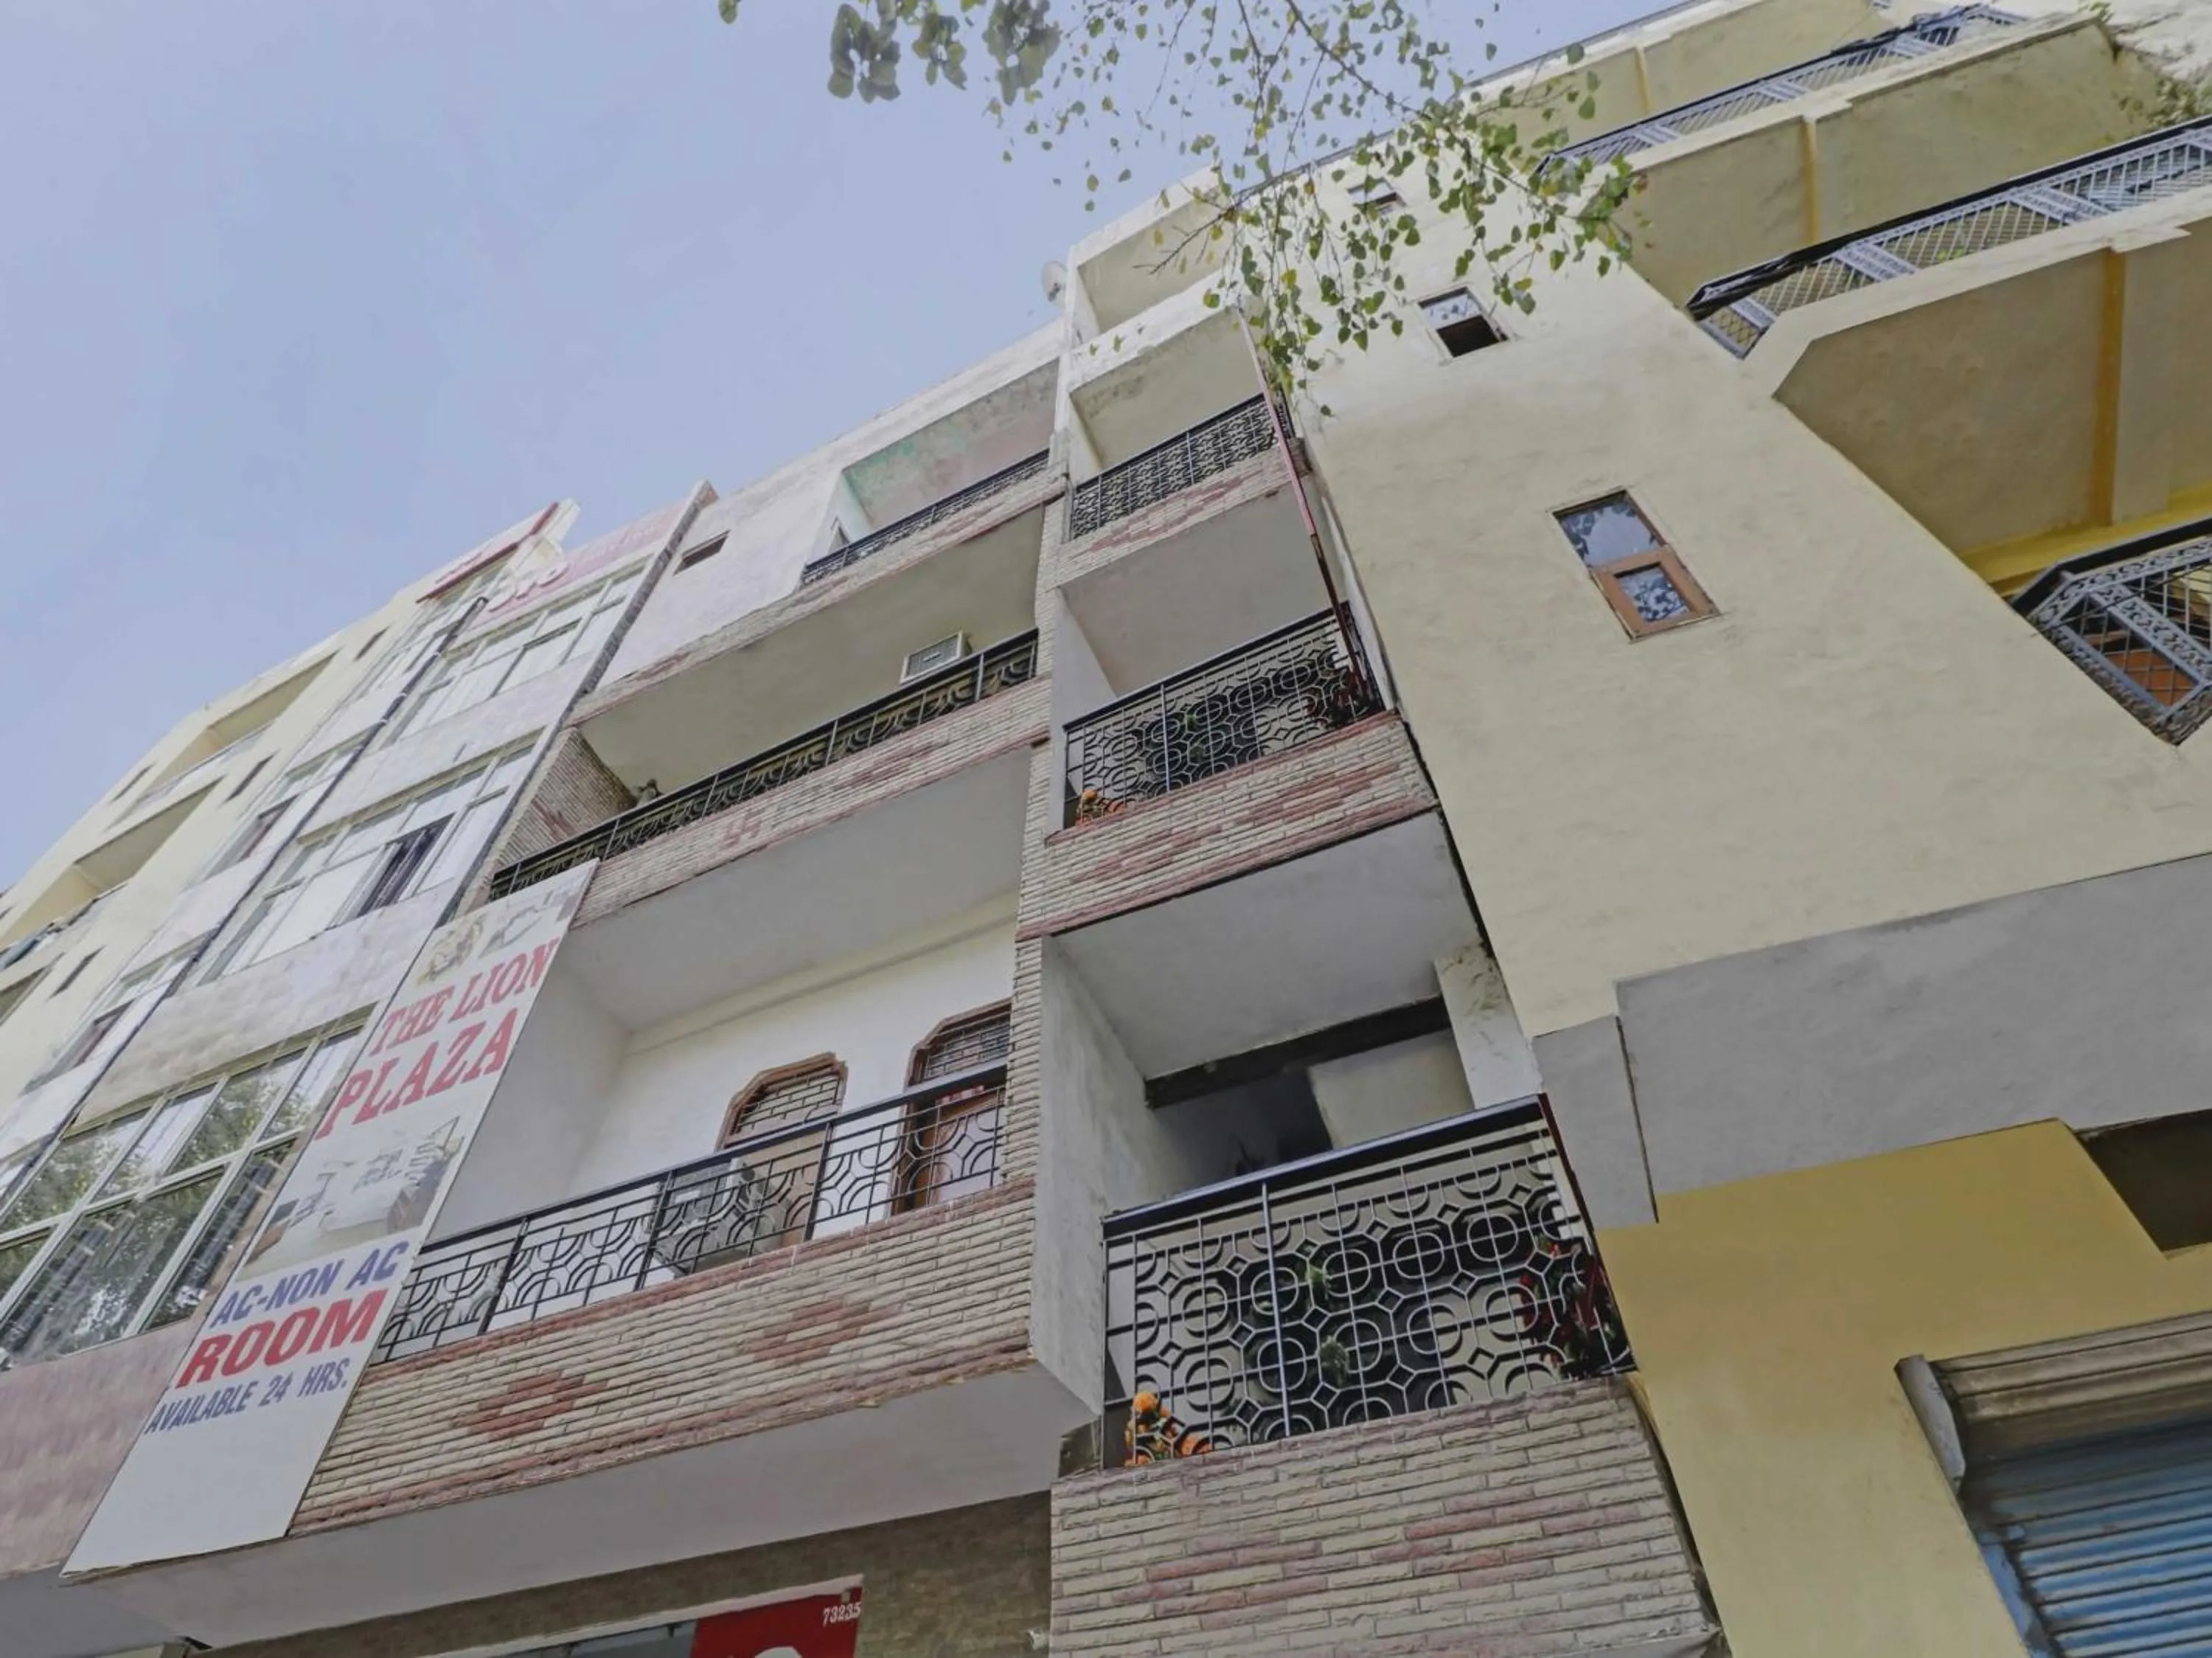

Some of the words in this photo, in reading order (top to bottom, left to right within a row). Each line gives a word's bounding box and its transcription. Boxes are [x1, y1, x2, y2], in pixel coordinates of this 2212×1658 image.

[369, 985, 455, 1057] THE
[448, 937, 560, 1023] LION
[315, 1007, 518, 1141] PLAZA
[209, 1259, 344, 1328] AC-NON
[345, 1241, 409, 1290] AC
[175, 1288, 389, 1389] ROOM
[144, 1381, 259, 1435] AVAILABLE
[259, 1371, 293, 1407] 24
[298, 1357, 350, 1397] HRS.
